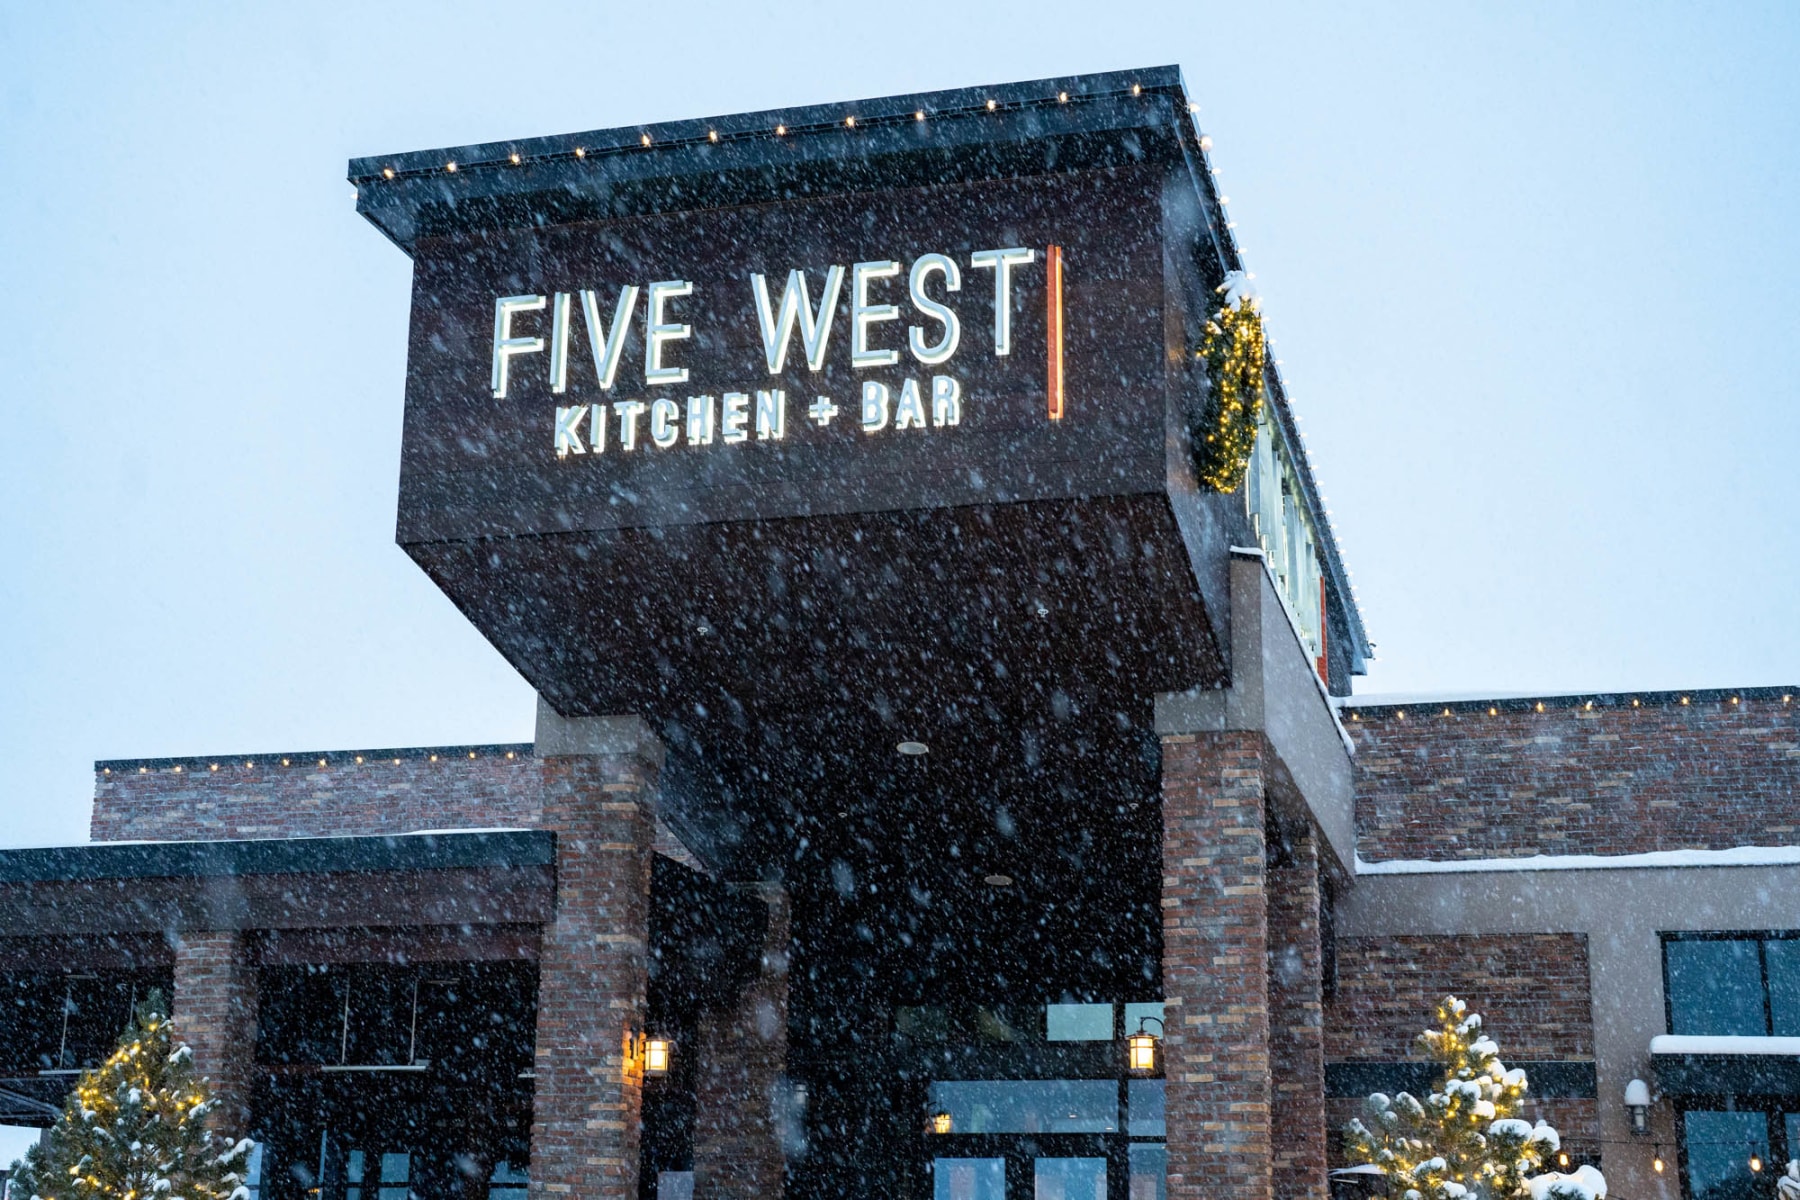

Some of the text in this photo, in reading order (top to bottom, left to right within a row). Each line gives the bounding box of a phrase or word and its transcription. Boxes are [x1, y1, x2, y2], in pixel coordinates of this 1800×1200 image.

[491, 247, 1035, 398] FIVE WEST
[553, 388, 785, 457] KITCHEN
[862, 375, 960, 432] BAR
